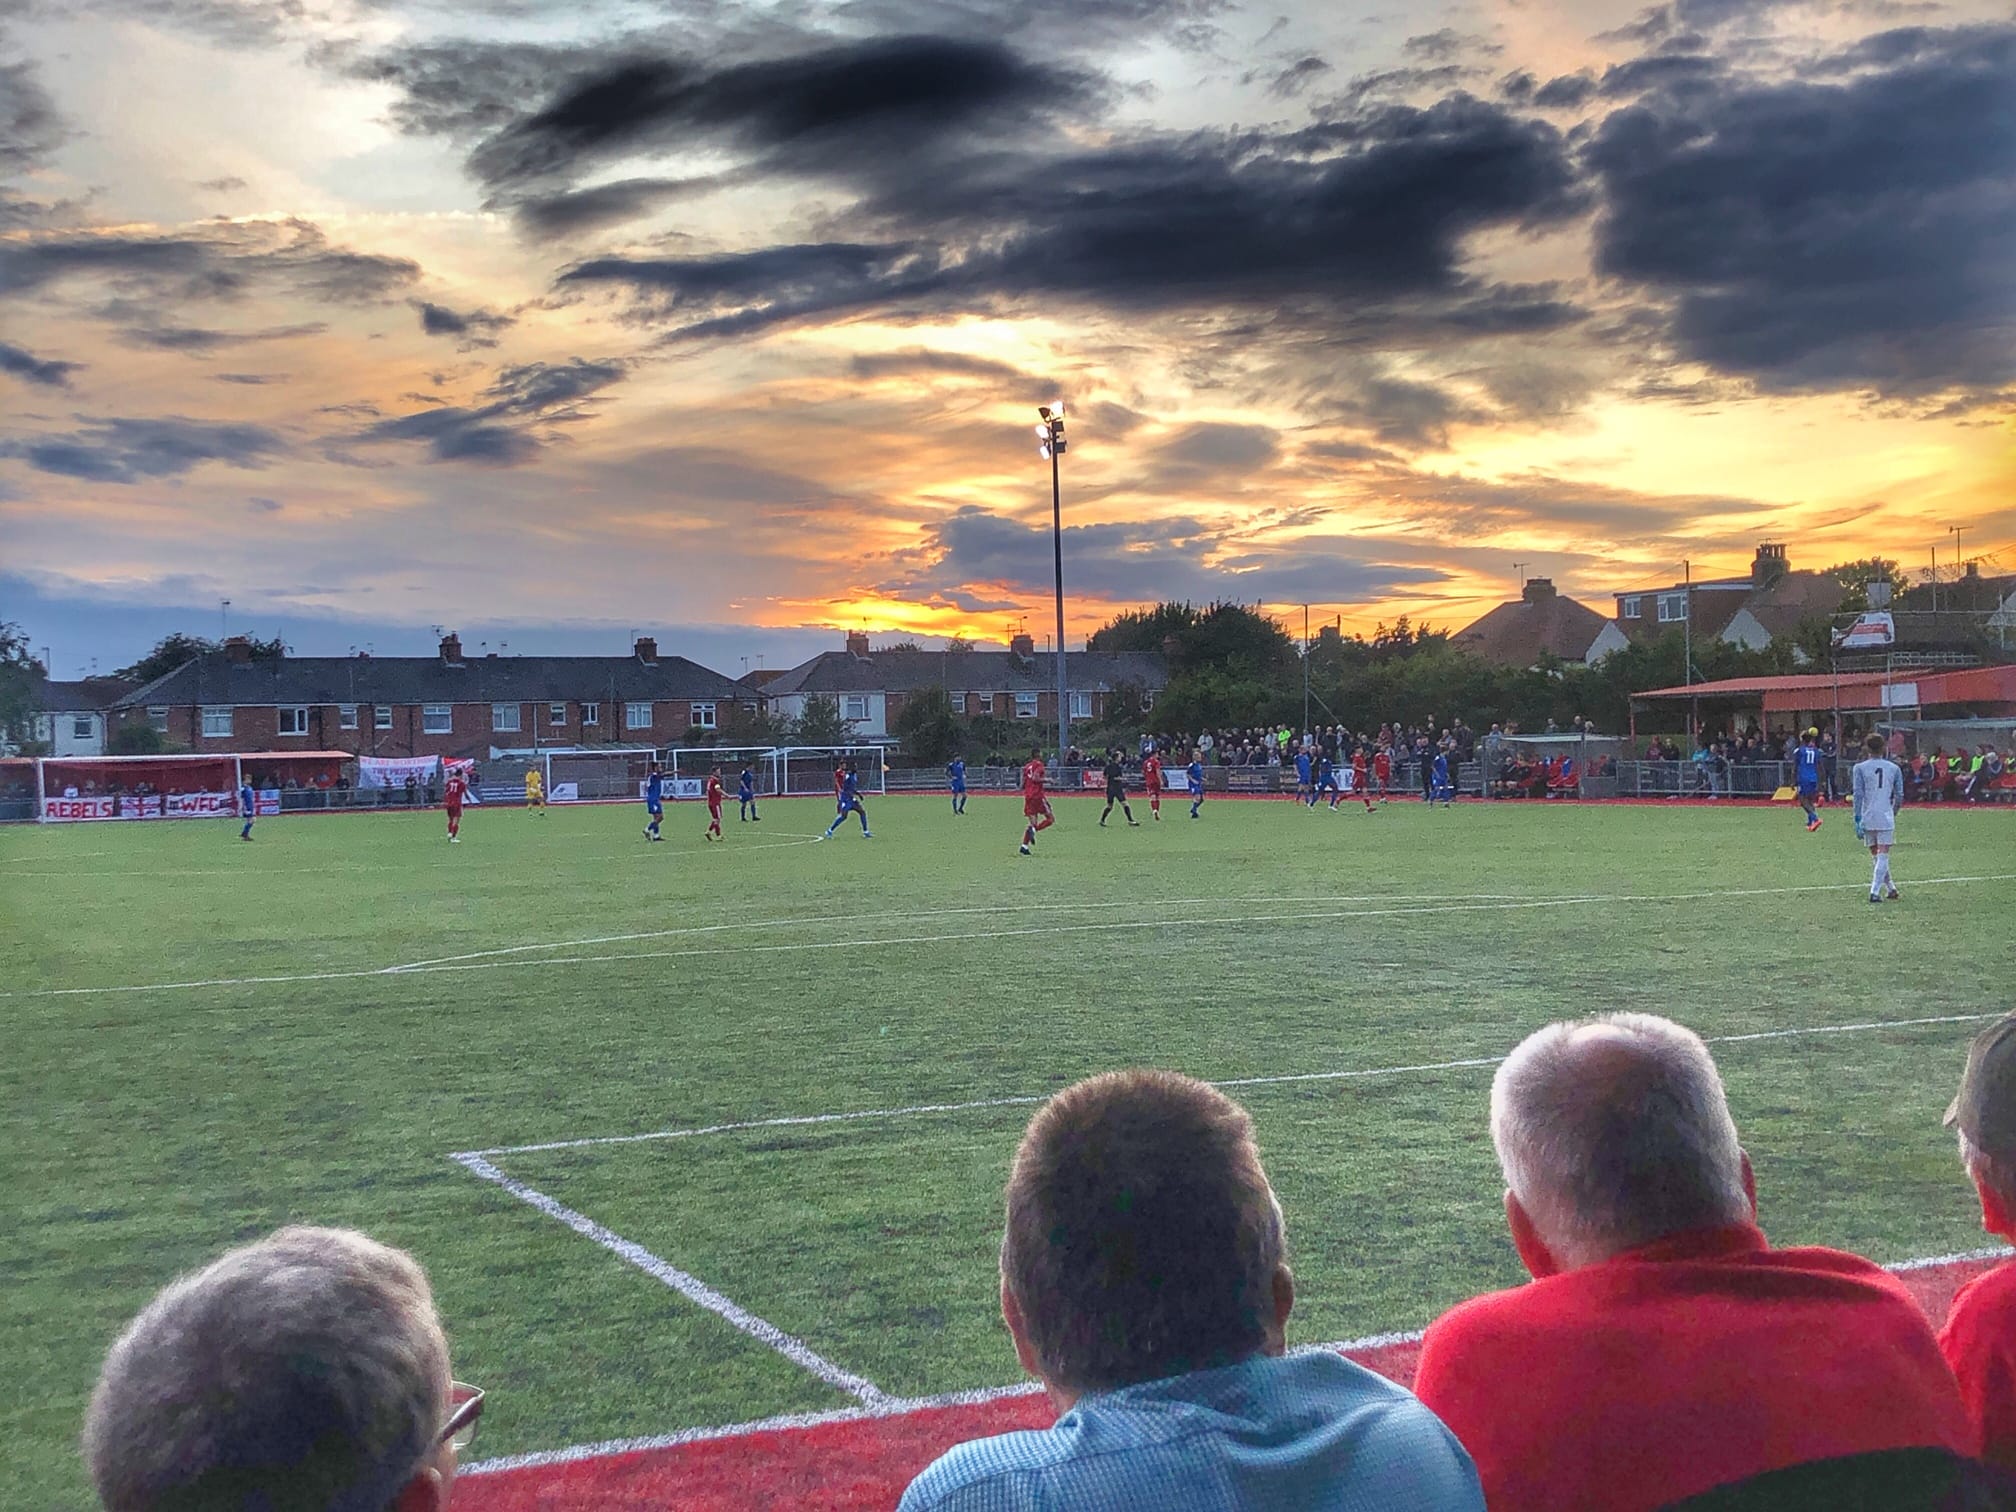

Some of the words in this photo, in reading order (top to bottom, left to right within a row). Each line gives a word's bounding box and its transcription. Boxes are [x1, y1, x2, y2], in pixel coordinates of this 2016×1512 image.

[1806, 750, 1815, 764] 11
[1874, 767, 1884, 789] 1
[449, 782, 458, 793] 11
[46, 802, 113, 818] REBELS
[181, 797, 218, 811] WFC
